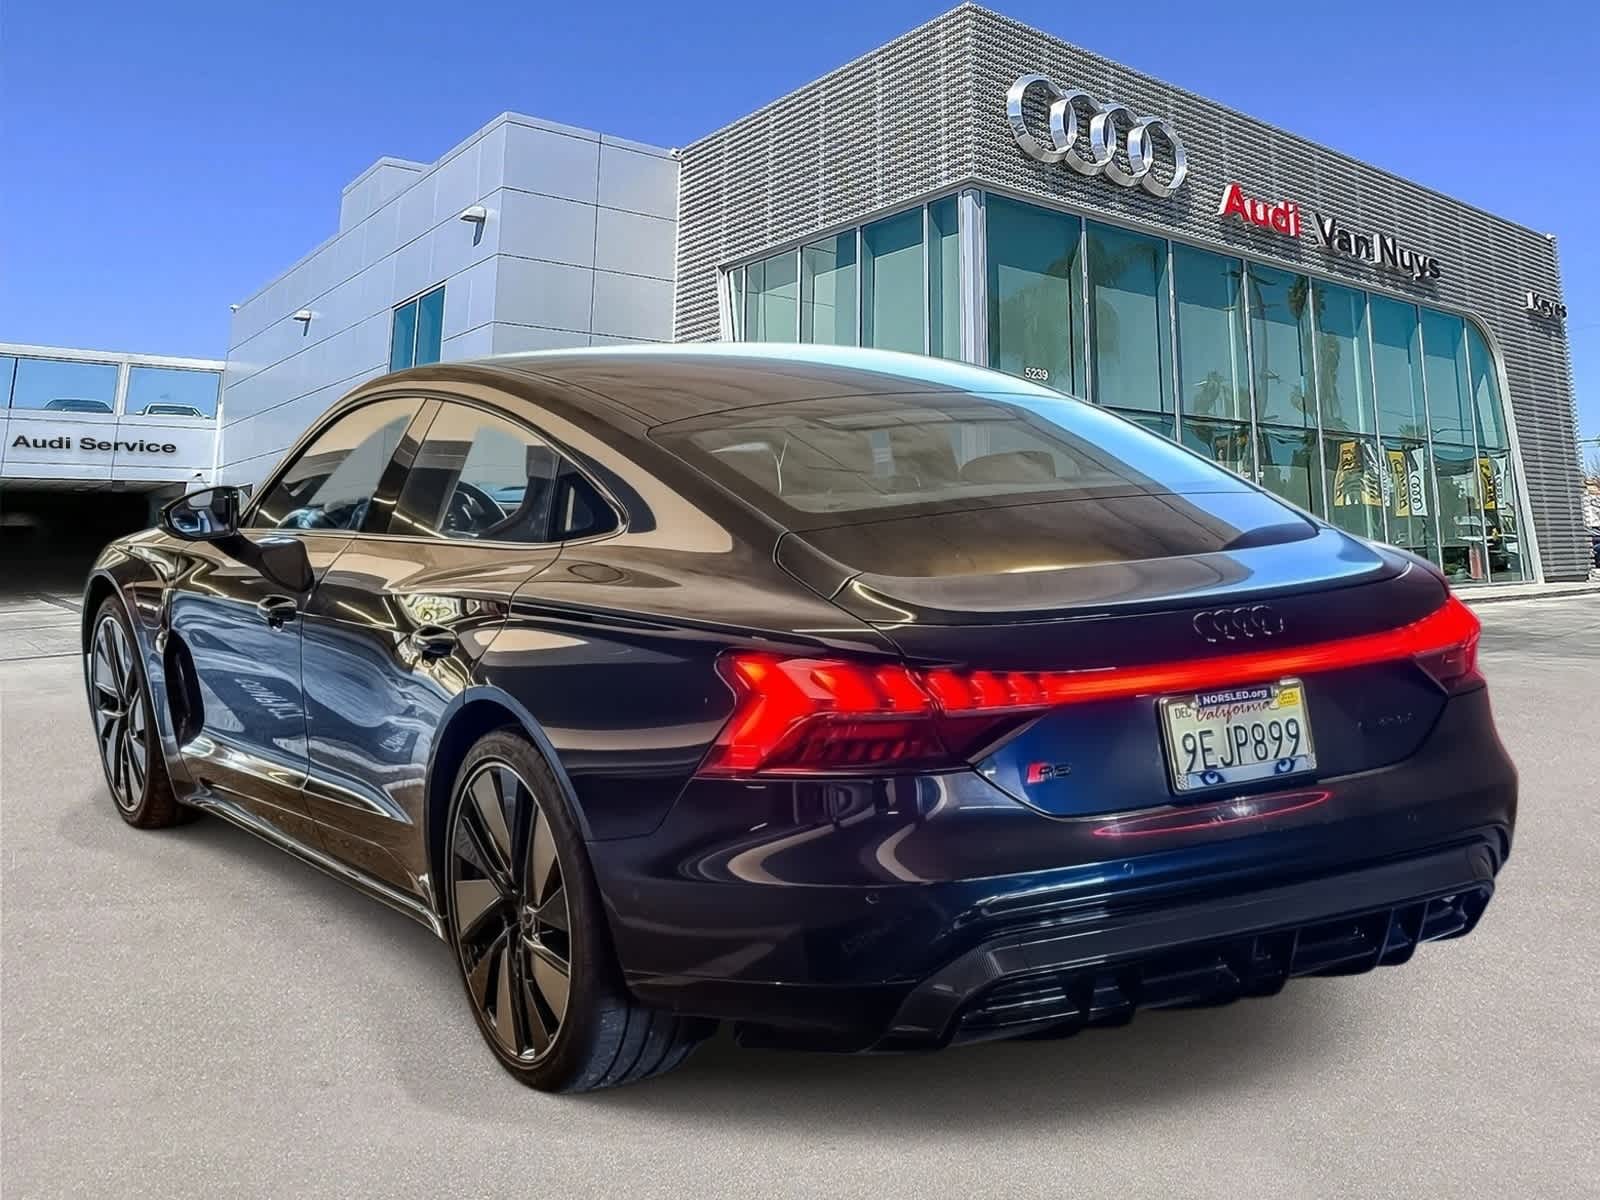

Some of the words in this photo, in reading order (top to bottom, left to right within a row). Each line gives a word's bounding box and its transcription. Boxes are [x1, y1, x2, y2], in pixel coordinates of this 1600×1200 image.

[1218, 183, 1301, 237] Audi
[1312, 212, 1374, 259] Van
[1373, 232, 1442, 281] Nuys
[1025, 367, 1048, 380] 5239
[12, 435, 71, 449] Audi
[80, 437, 177, 453] Service
[1202, 689, 1267, 705] NORSLED.org
[1175, 707, 1191, 719] DEC
[1196, 701, 1279, 724] California
[1182, 718, 1300, 771] 9EJP899
